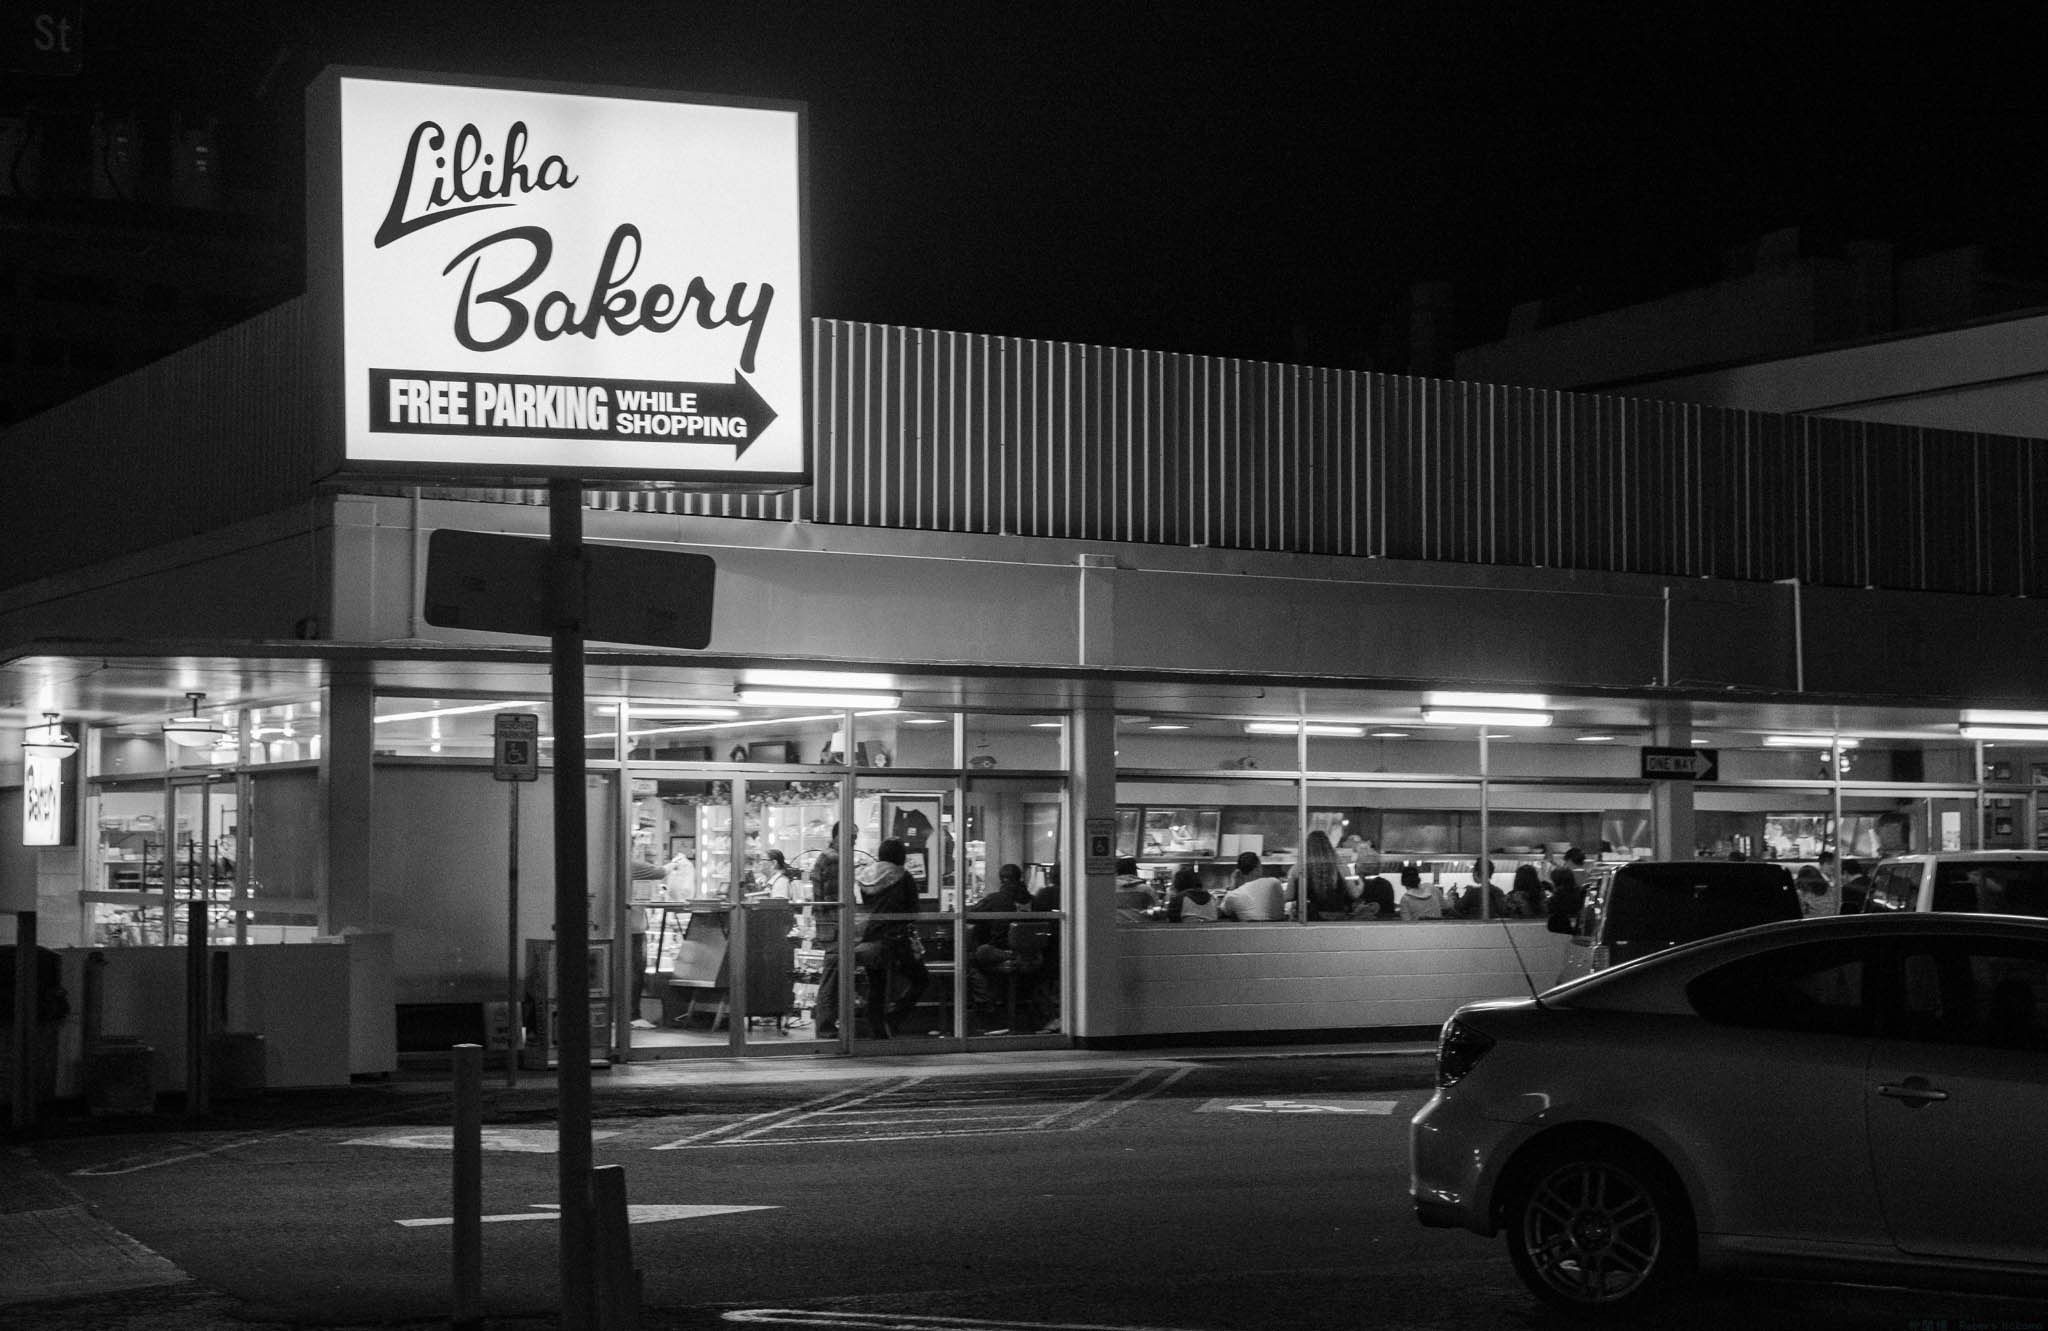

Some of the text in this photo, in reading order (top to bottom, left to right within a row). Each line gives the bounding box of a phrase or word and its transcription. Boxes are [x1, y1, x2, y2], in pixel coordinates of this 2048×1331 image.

[33, 14, 71, 53] St
[374, 120, 579, 249] Liliha
[442, 222, 775, 374] Bakery
[389, 378, 609, 431] FREE PARKING
[616, 390, 697, 413] WHILE
[616, 413, 748, 439] SHOPPING
[1649, 757, 1696, 771] ONE WAY
